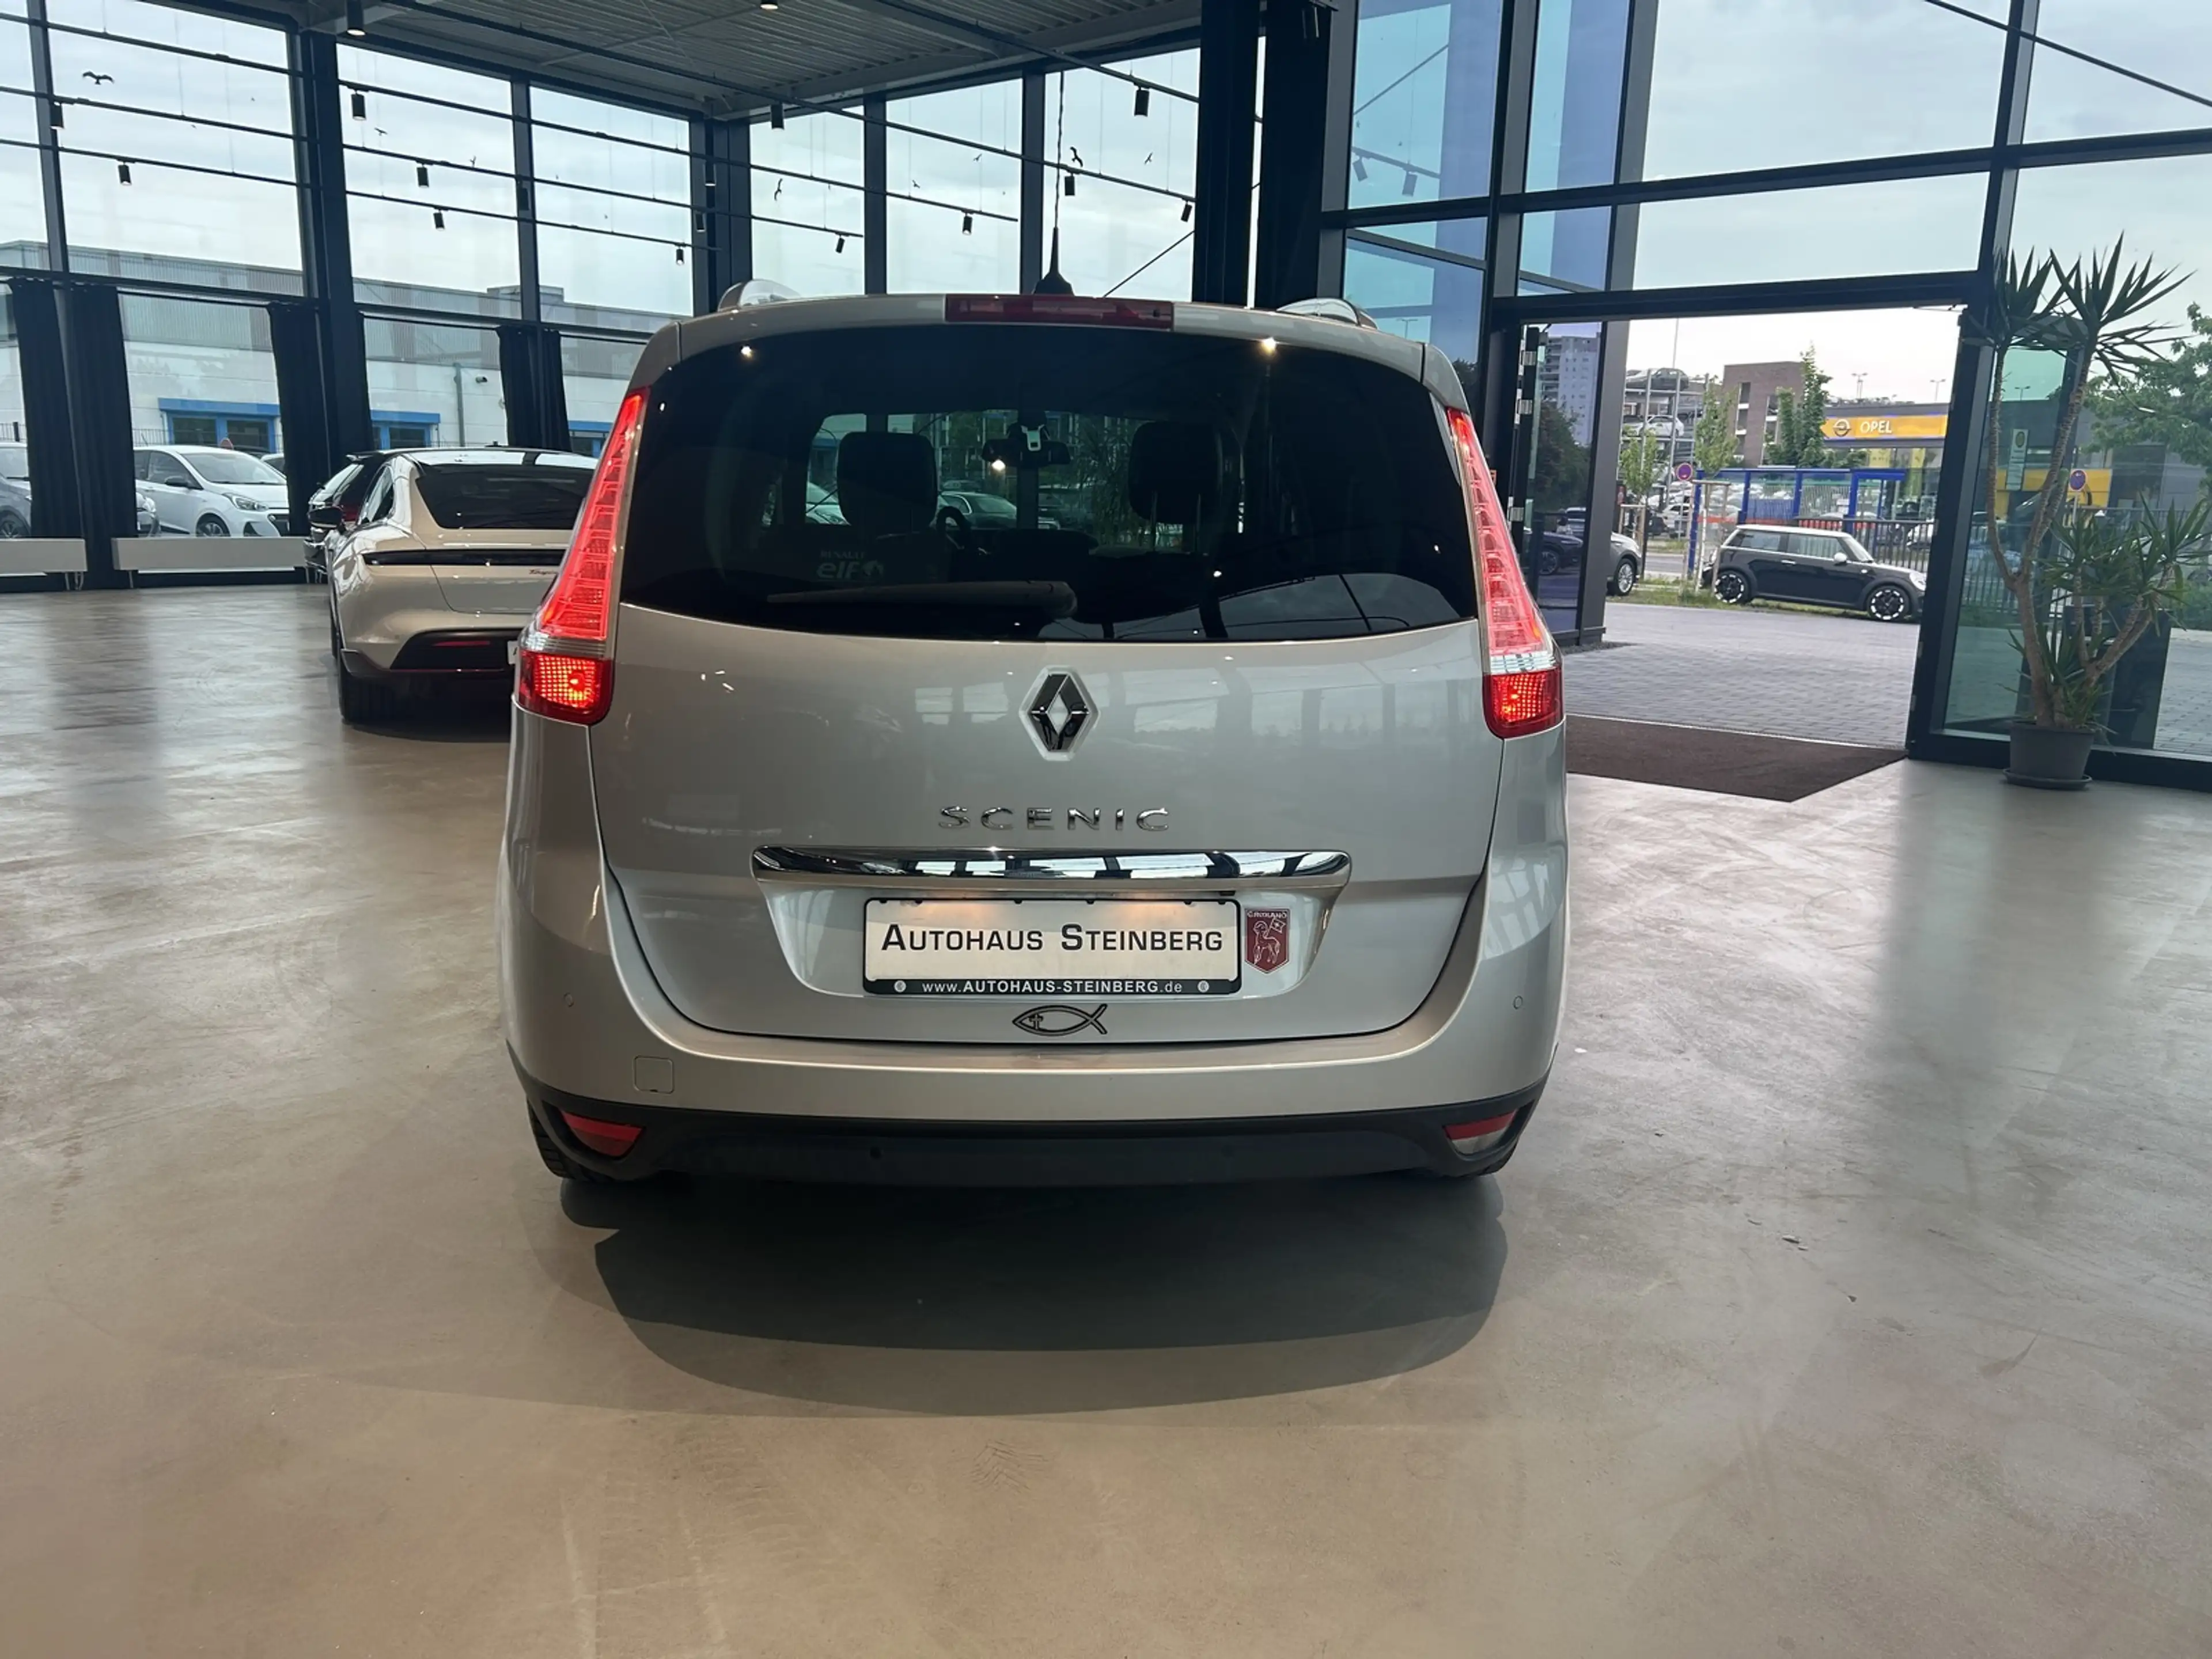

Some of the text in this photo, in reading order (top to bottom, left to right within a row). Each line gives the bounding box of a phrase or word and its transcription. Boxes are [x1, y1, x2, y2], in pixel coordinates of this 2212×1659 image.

[1859, 420, 1892, 434] OPEL
[938, 805, 1169, 831] SCENIC
[922, 980, 1183, 993] www.AUTOHAUS-STEINBERG.de
